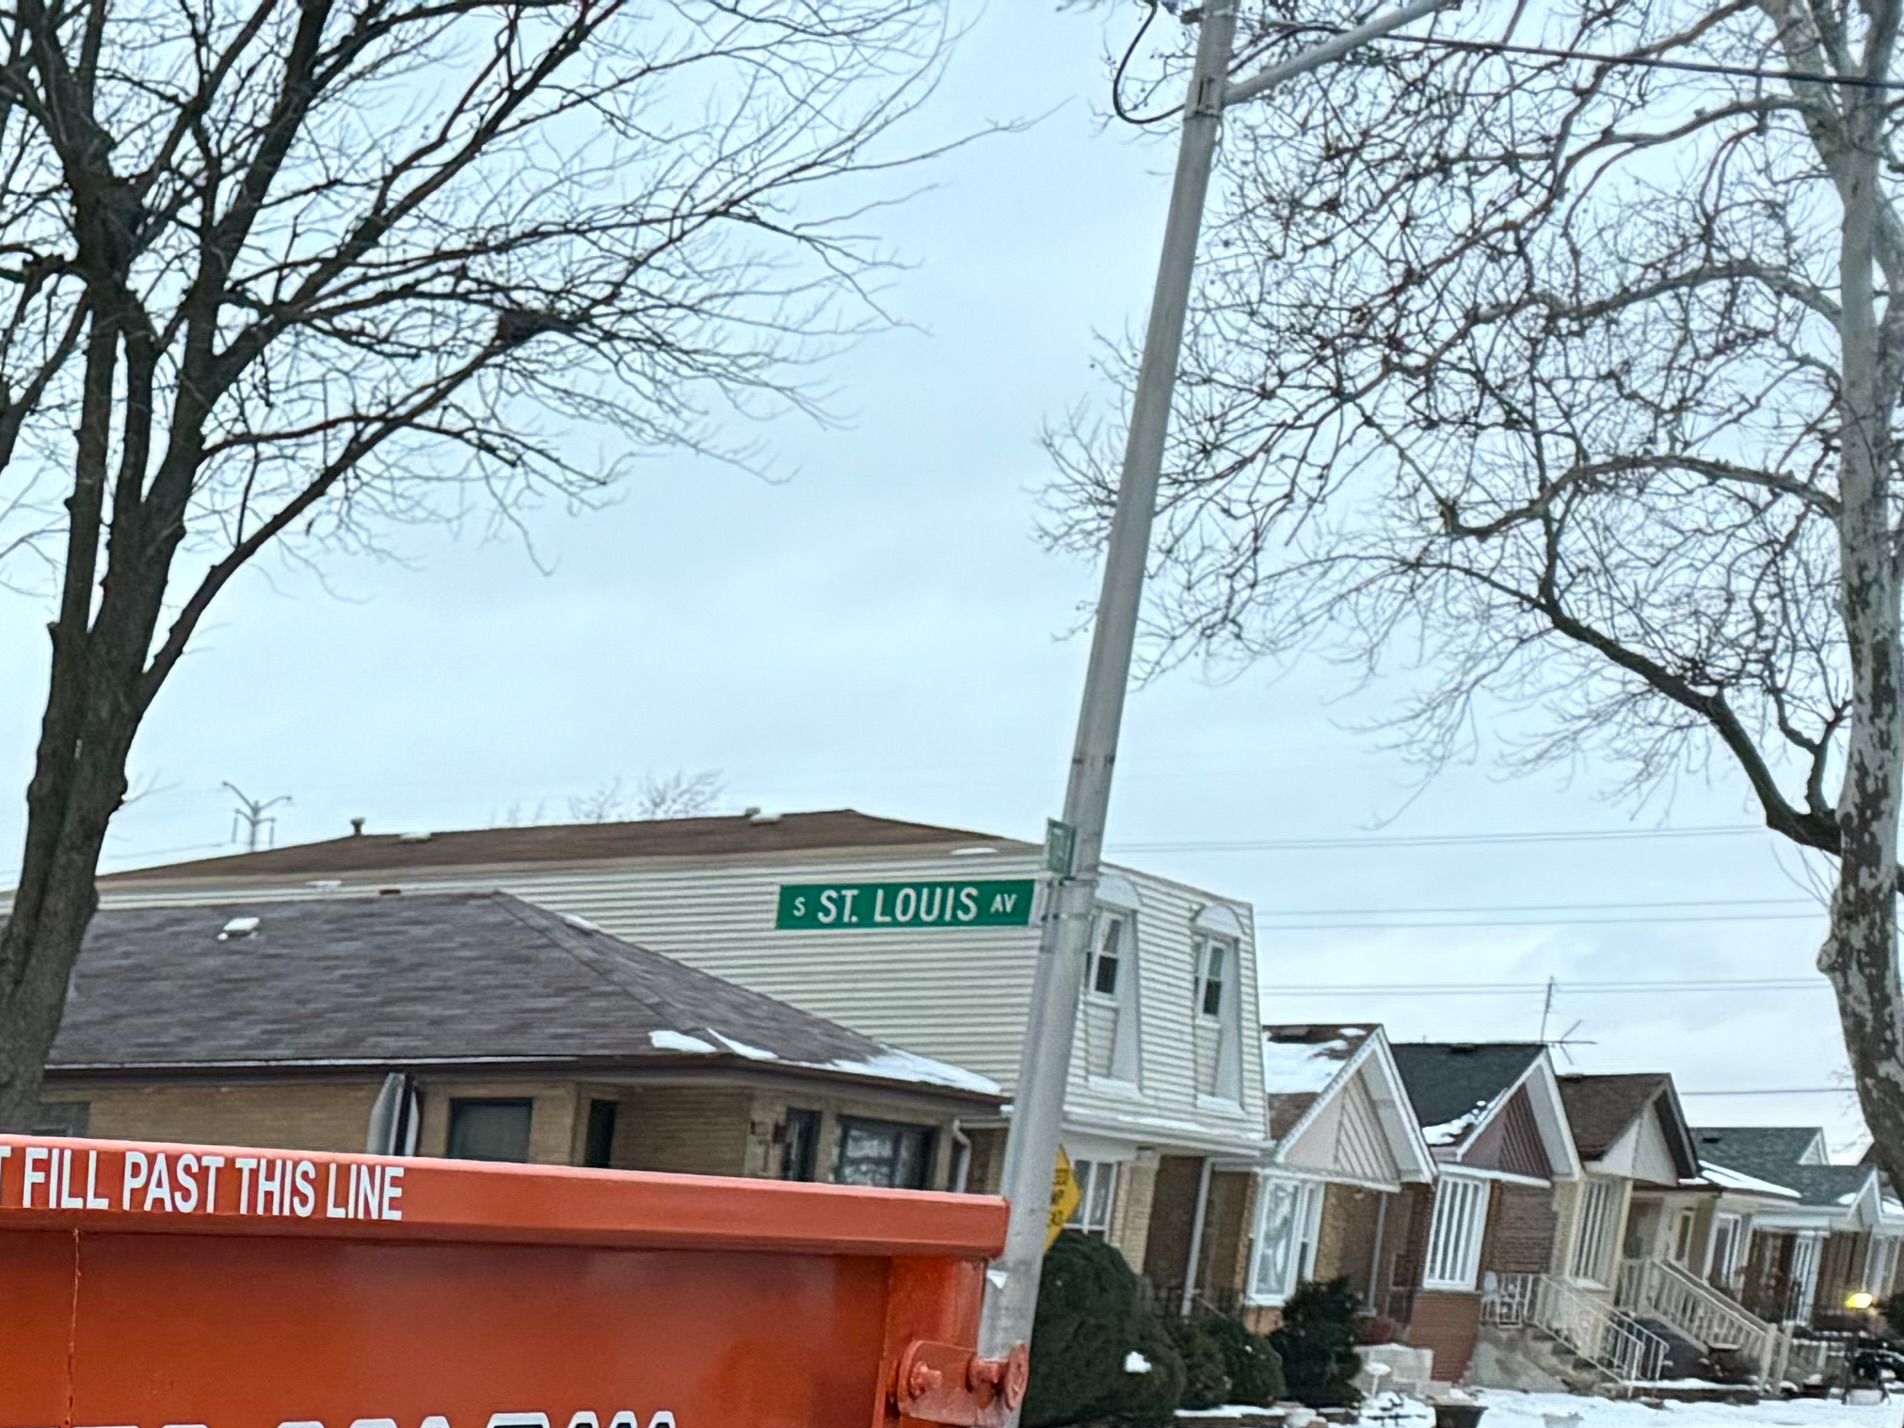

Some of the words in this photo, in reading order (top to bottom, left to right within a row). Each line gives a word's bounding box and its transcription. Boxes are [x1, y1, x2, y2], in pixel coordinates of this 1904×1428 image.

[793, 897, 805, 917] S
[817, 889, 859, 924] ST.
[873, 887, 978, 923] LOUIS
[990, 893, 1018, 914] AV
[23, 1147, 109, 1210] FILL
[122, 1151, 225, 1214] PAST
[235, 1158, 316, 1218] THIS
[326, 1162, 405, 1221] LINE
